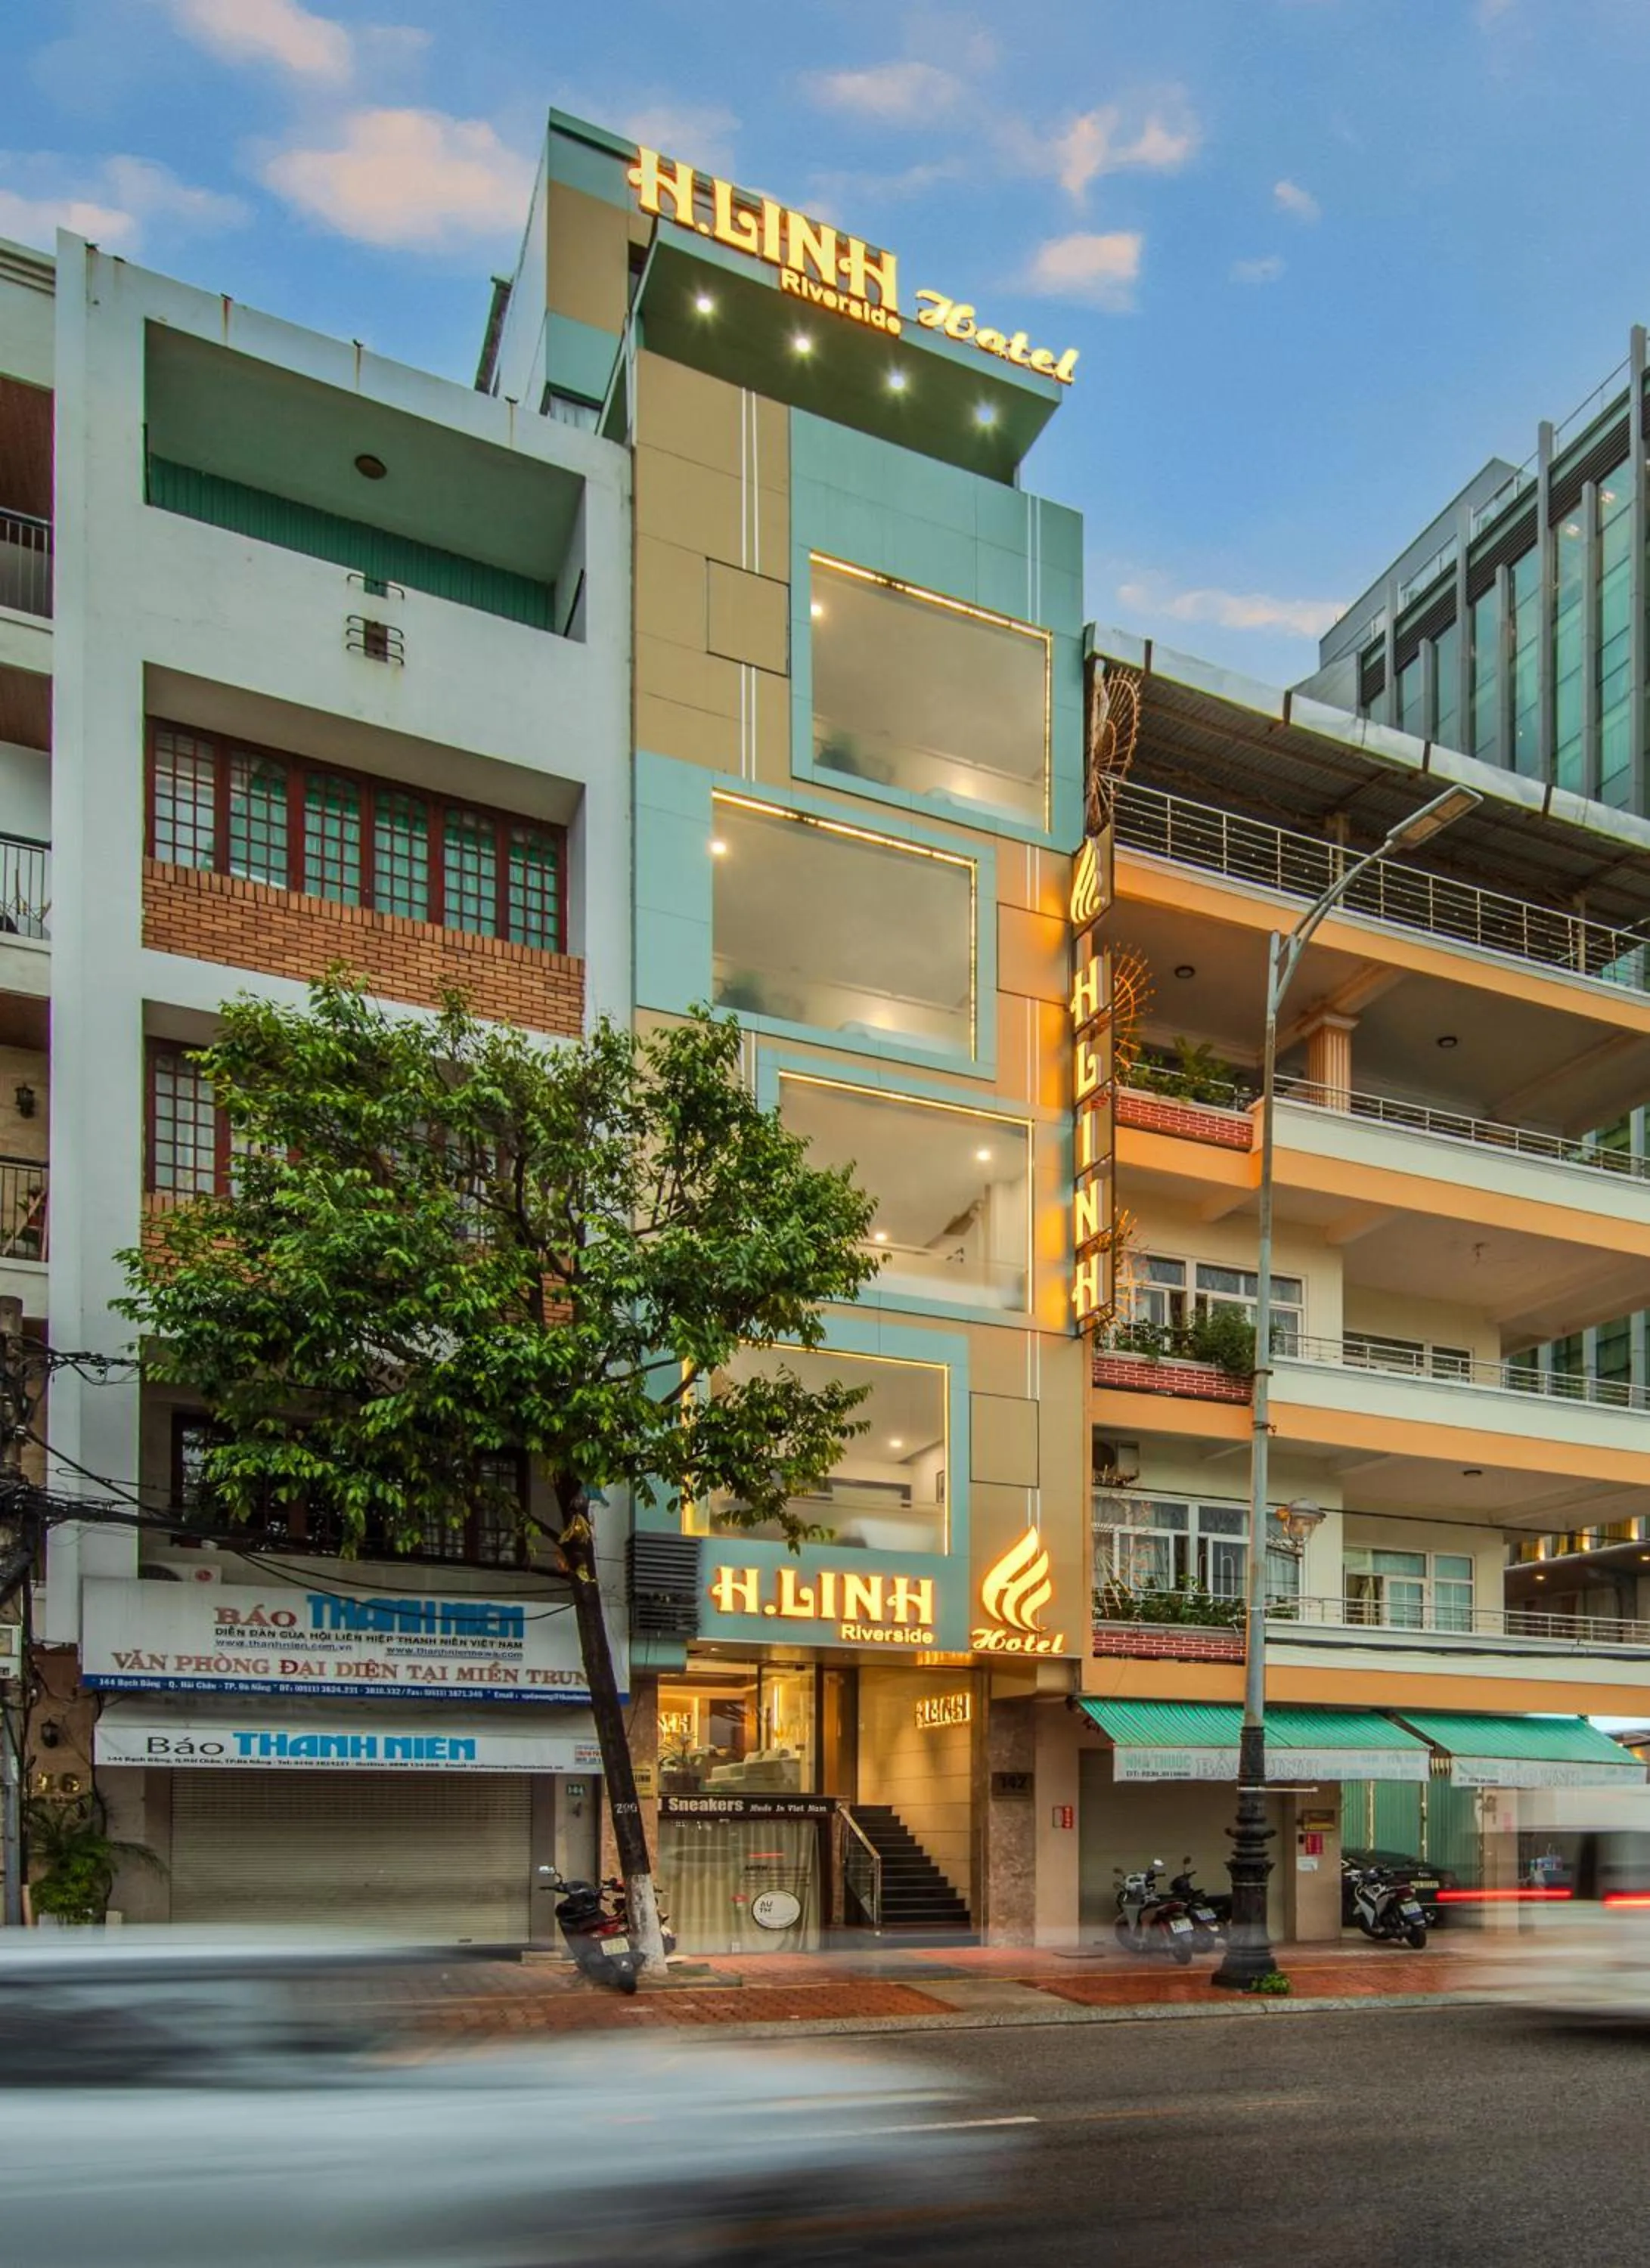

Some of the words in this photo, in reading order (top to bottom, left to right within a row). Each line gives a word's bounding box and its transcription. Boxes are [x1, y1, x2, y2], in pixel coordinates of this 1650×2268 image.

[627, 146, 899, 314] H.LINH
[780, 266, 903, 338] Riverside
[914, 289, 1080, 384] Hotel
[712, 1566, 933, 1625] H.LINH
[215, 1603, 297, 1627] BÁO
[397, 1635, 437, 1645] THANH
[498, 1640, 523, 1650] NAM
[841, 1623, 934, 1645] Riverside
[969, 1628, 1065, 1655] Hotel
[111, 1649, 169, 1671] VĂN
[173, 1652, 271, 1675] PHÒNG
[278, 1659, 327, 1679] ĐẠI
[335, 1658, 400, 1681] DIỆN
[406, 1663, 448, 1684] TẠI
[526, 1668, 588, 1686] TRUN
[147, 1737, 225, 1755] Báo
[232, 1731, 377, 1758] THANH
[668, 1797, 745, 1812] Sneakers
